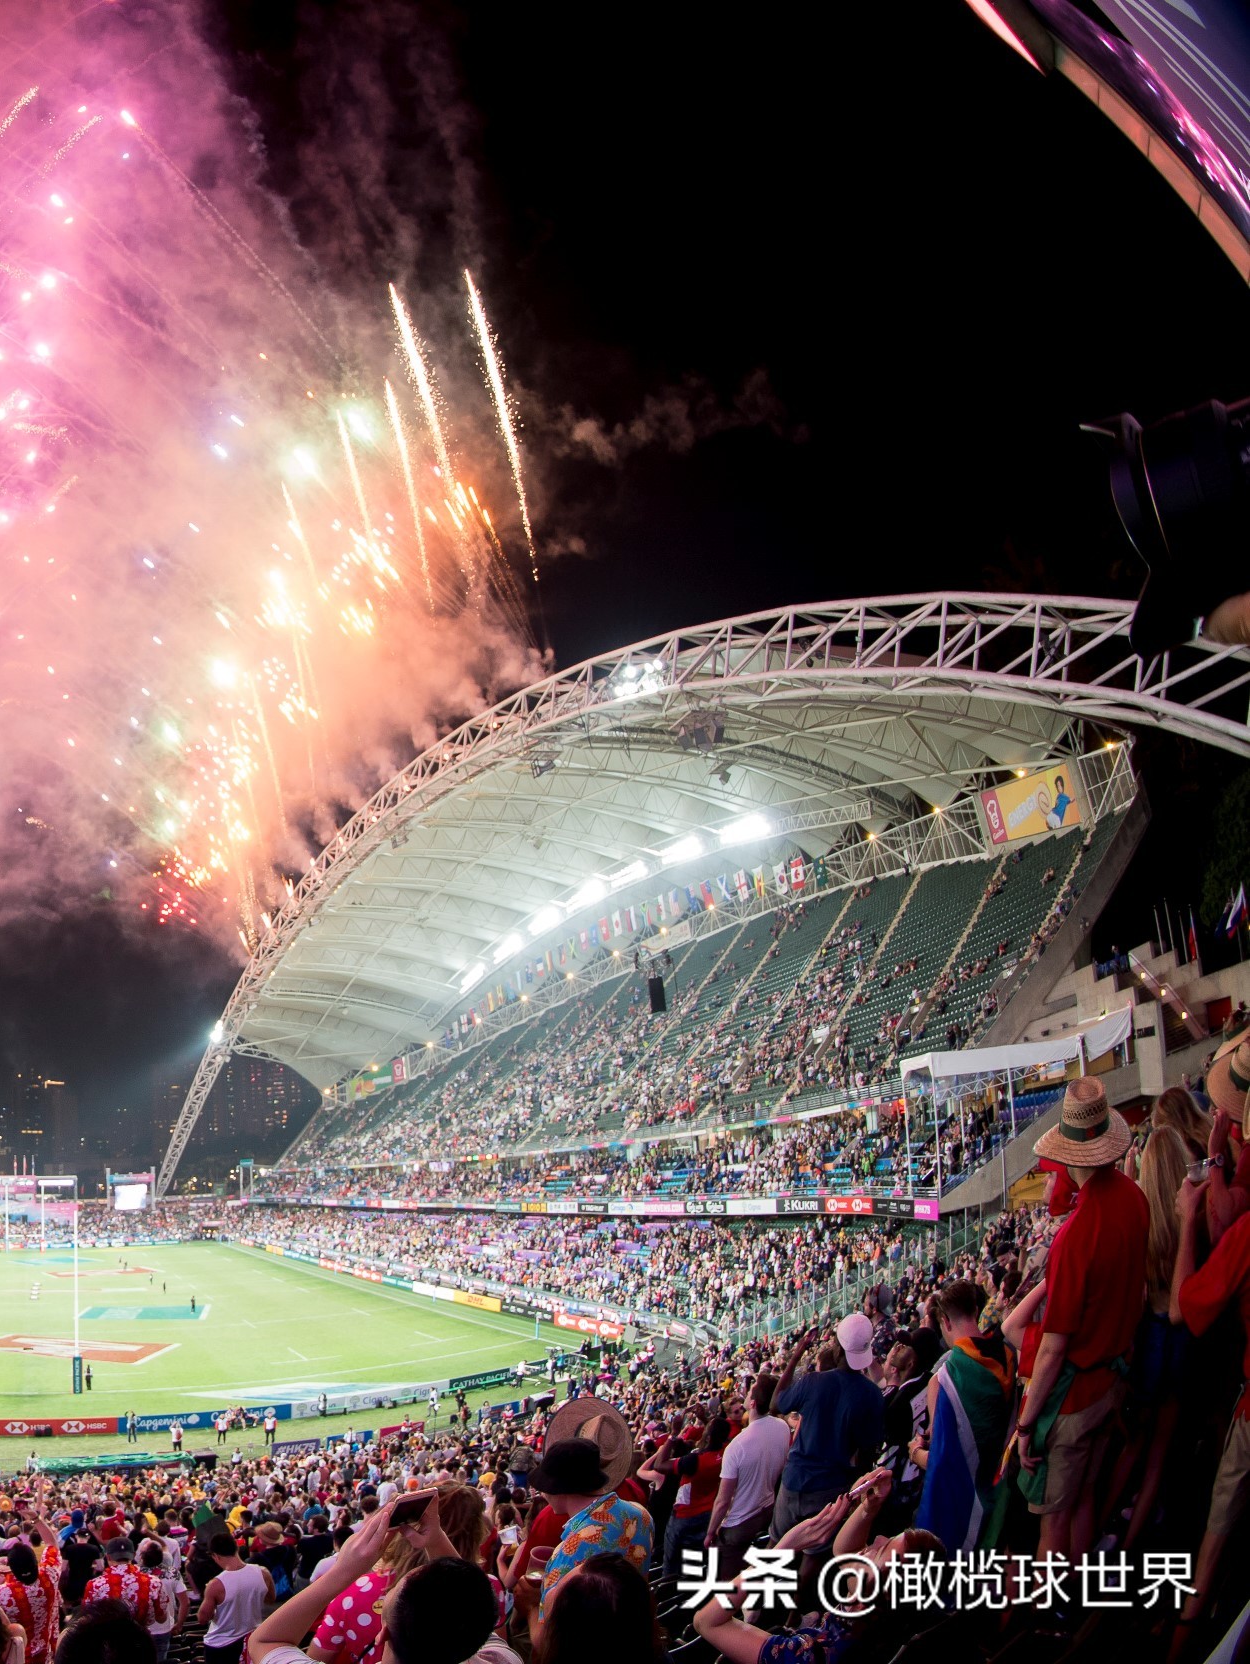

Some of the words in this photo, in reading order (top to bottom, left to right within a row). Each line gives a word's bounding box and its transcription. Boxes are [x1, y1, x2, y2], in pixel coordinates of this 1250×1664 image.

[791, 1200, 818, 1211] KUKRI
[453, 1376, 485, 1389] CATHAY
[486, 1371, 515, 1383] PACIFIC
[135, 1415, 187, 1431] Capgemini
[276, 1442, 316, 1456] #HK7S
